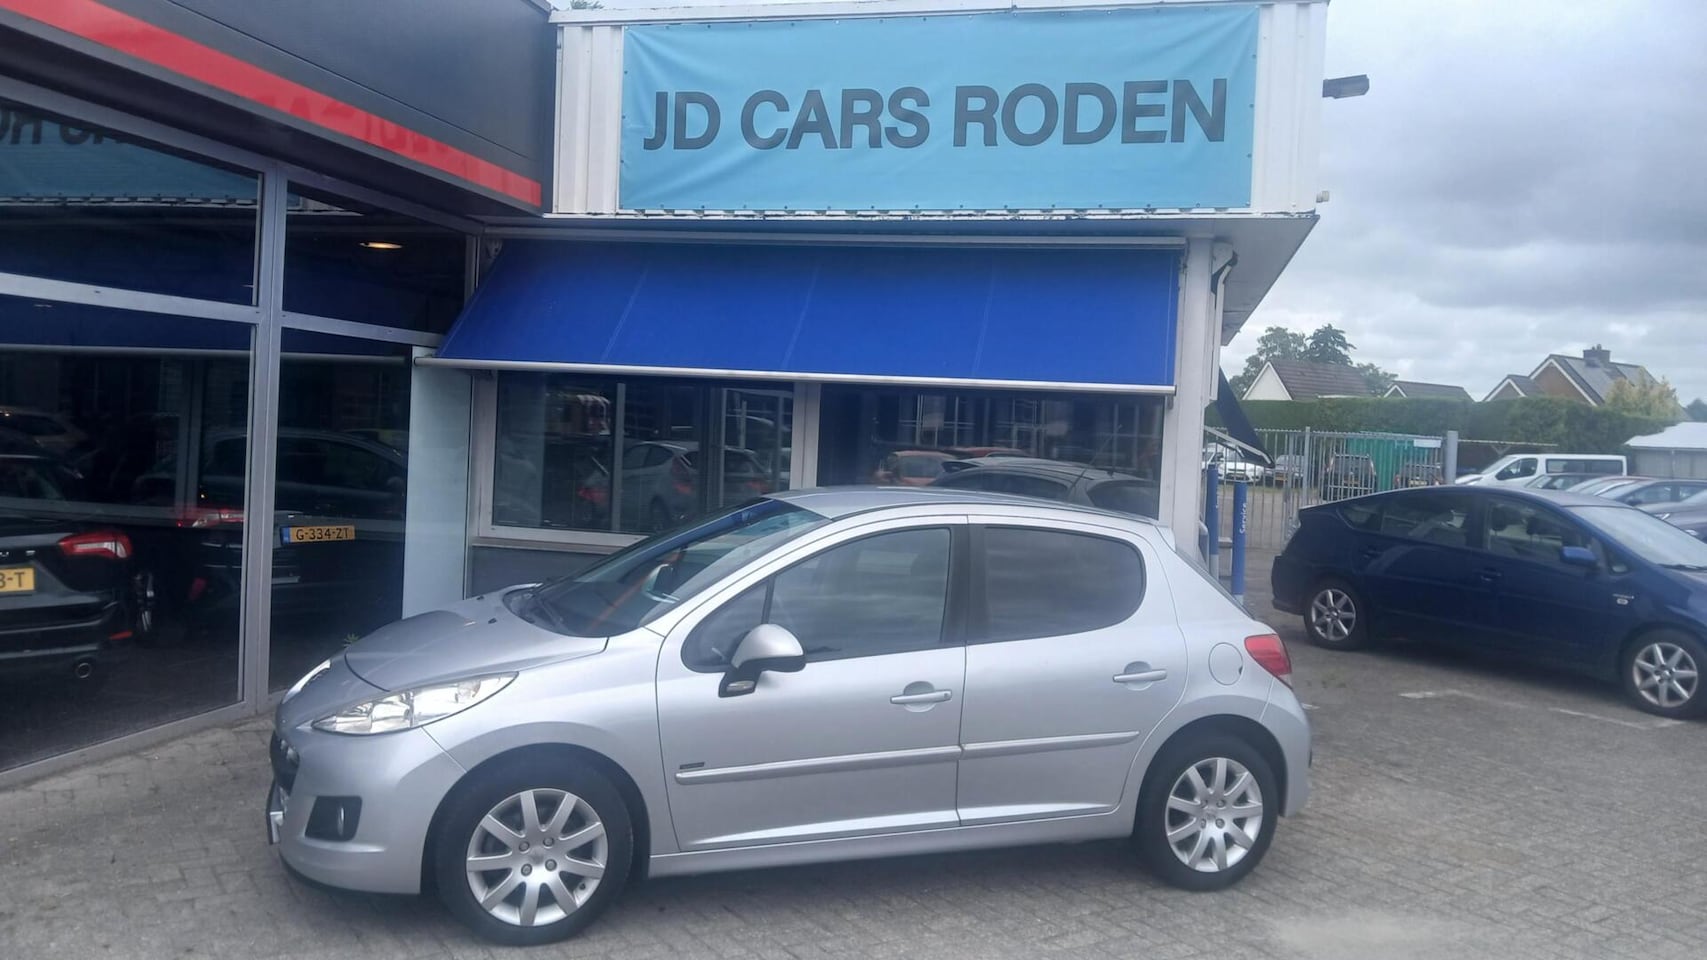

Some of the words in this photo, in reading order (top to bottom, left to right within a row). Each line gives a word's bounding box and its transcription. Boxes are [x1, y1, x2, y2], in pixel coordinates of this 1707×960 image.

[643, 91, 721, 151] JD
[740, 86, 930, 150] CARS
[953, 78, 1228, 148] RODEN
[295, 527, 350, 540] G-334-ZT
